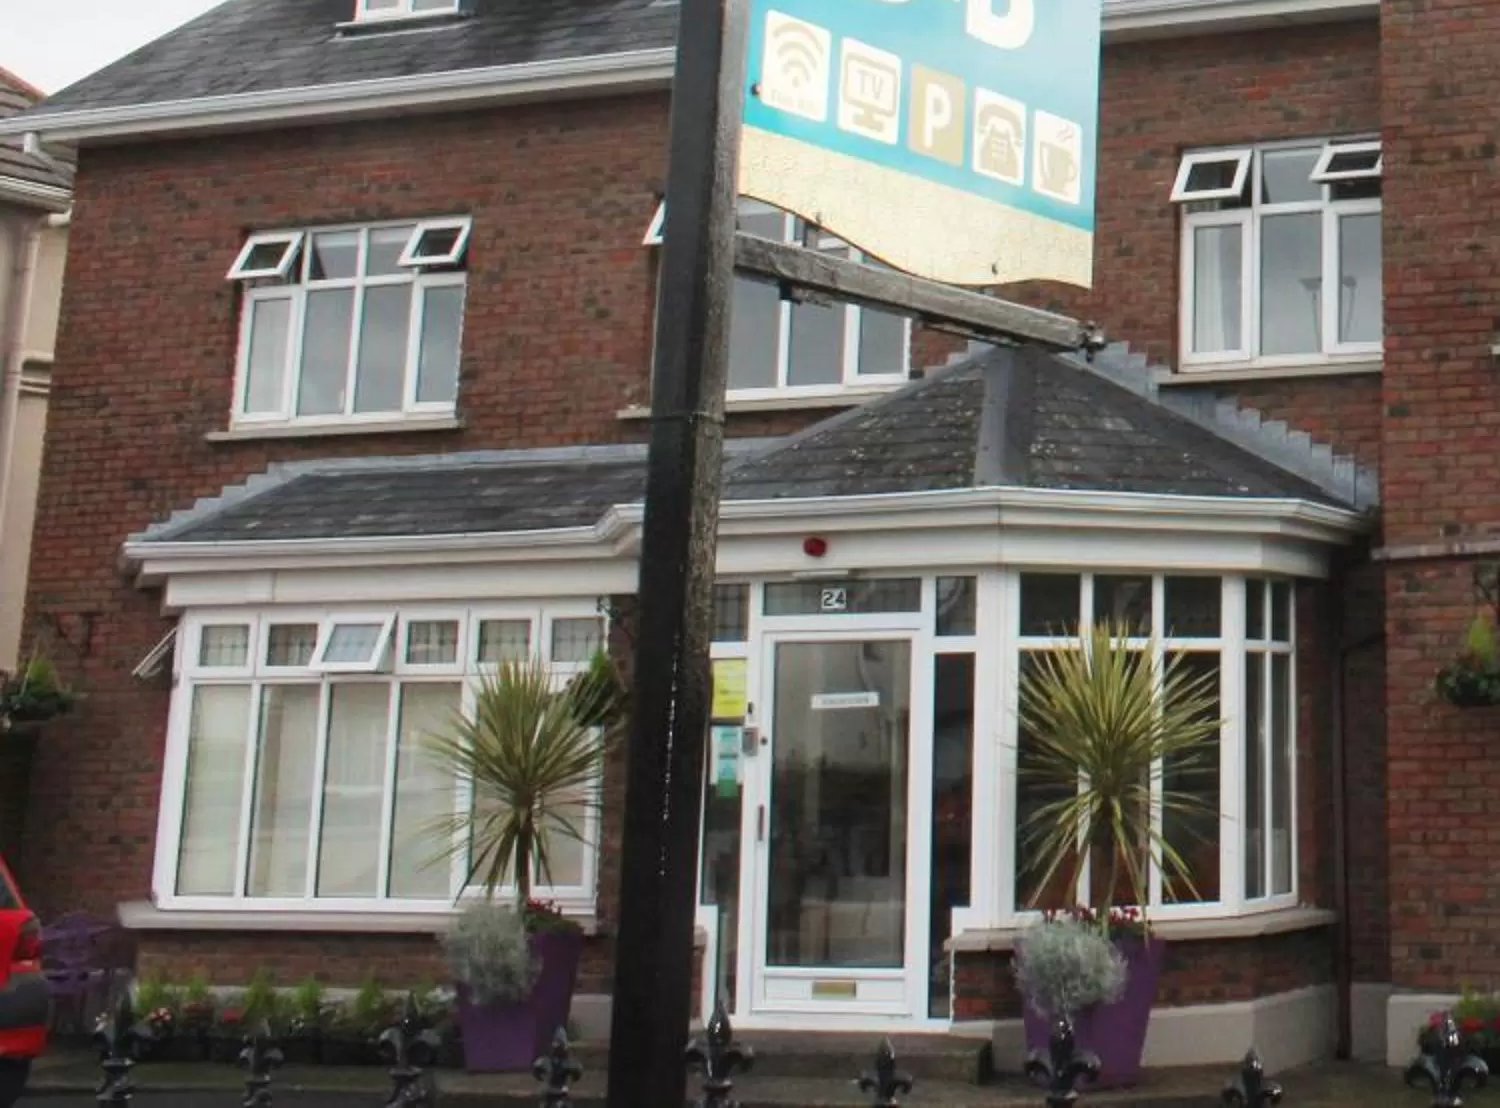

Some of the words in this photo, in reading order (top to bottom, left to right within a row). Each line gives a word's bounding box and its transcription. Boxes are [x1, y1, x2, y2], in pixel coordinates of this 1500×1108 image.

[857, 68, 884, 100] TV
[922, 82, 953, 149] P
[823, 591, 845, 607] 24
